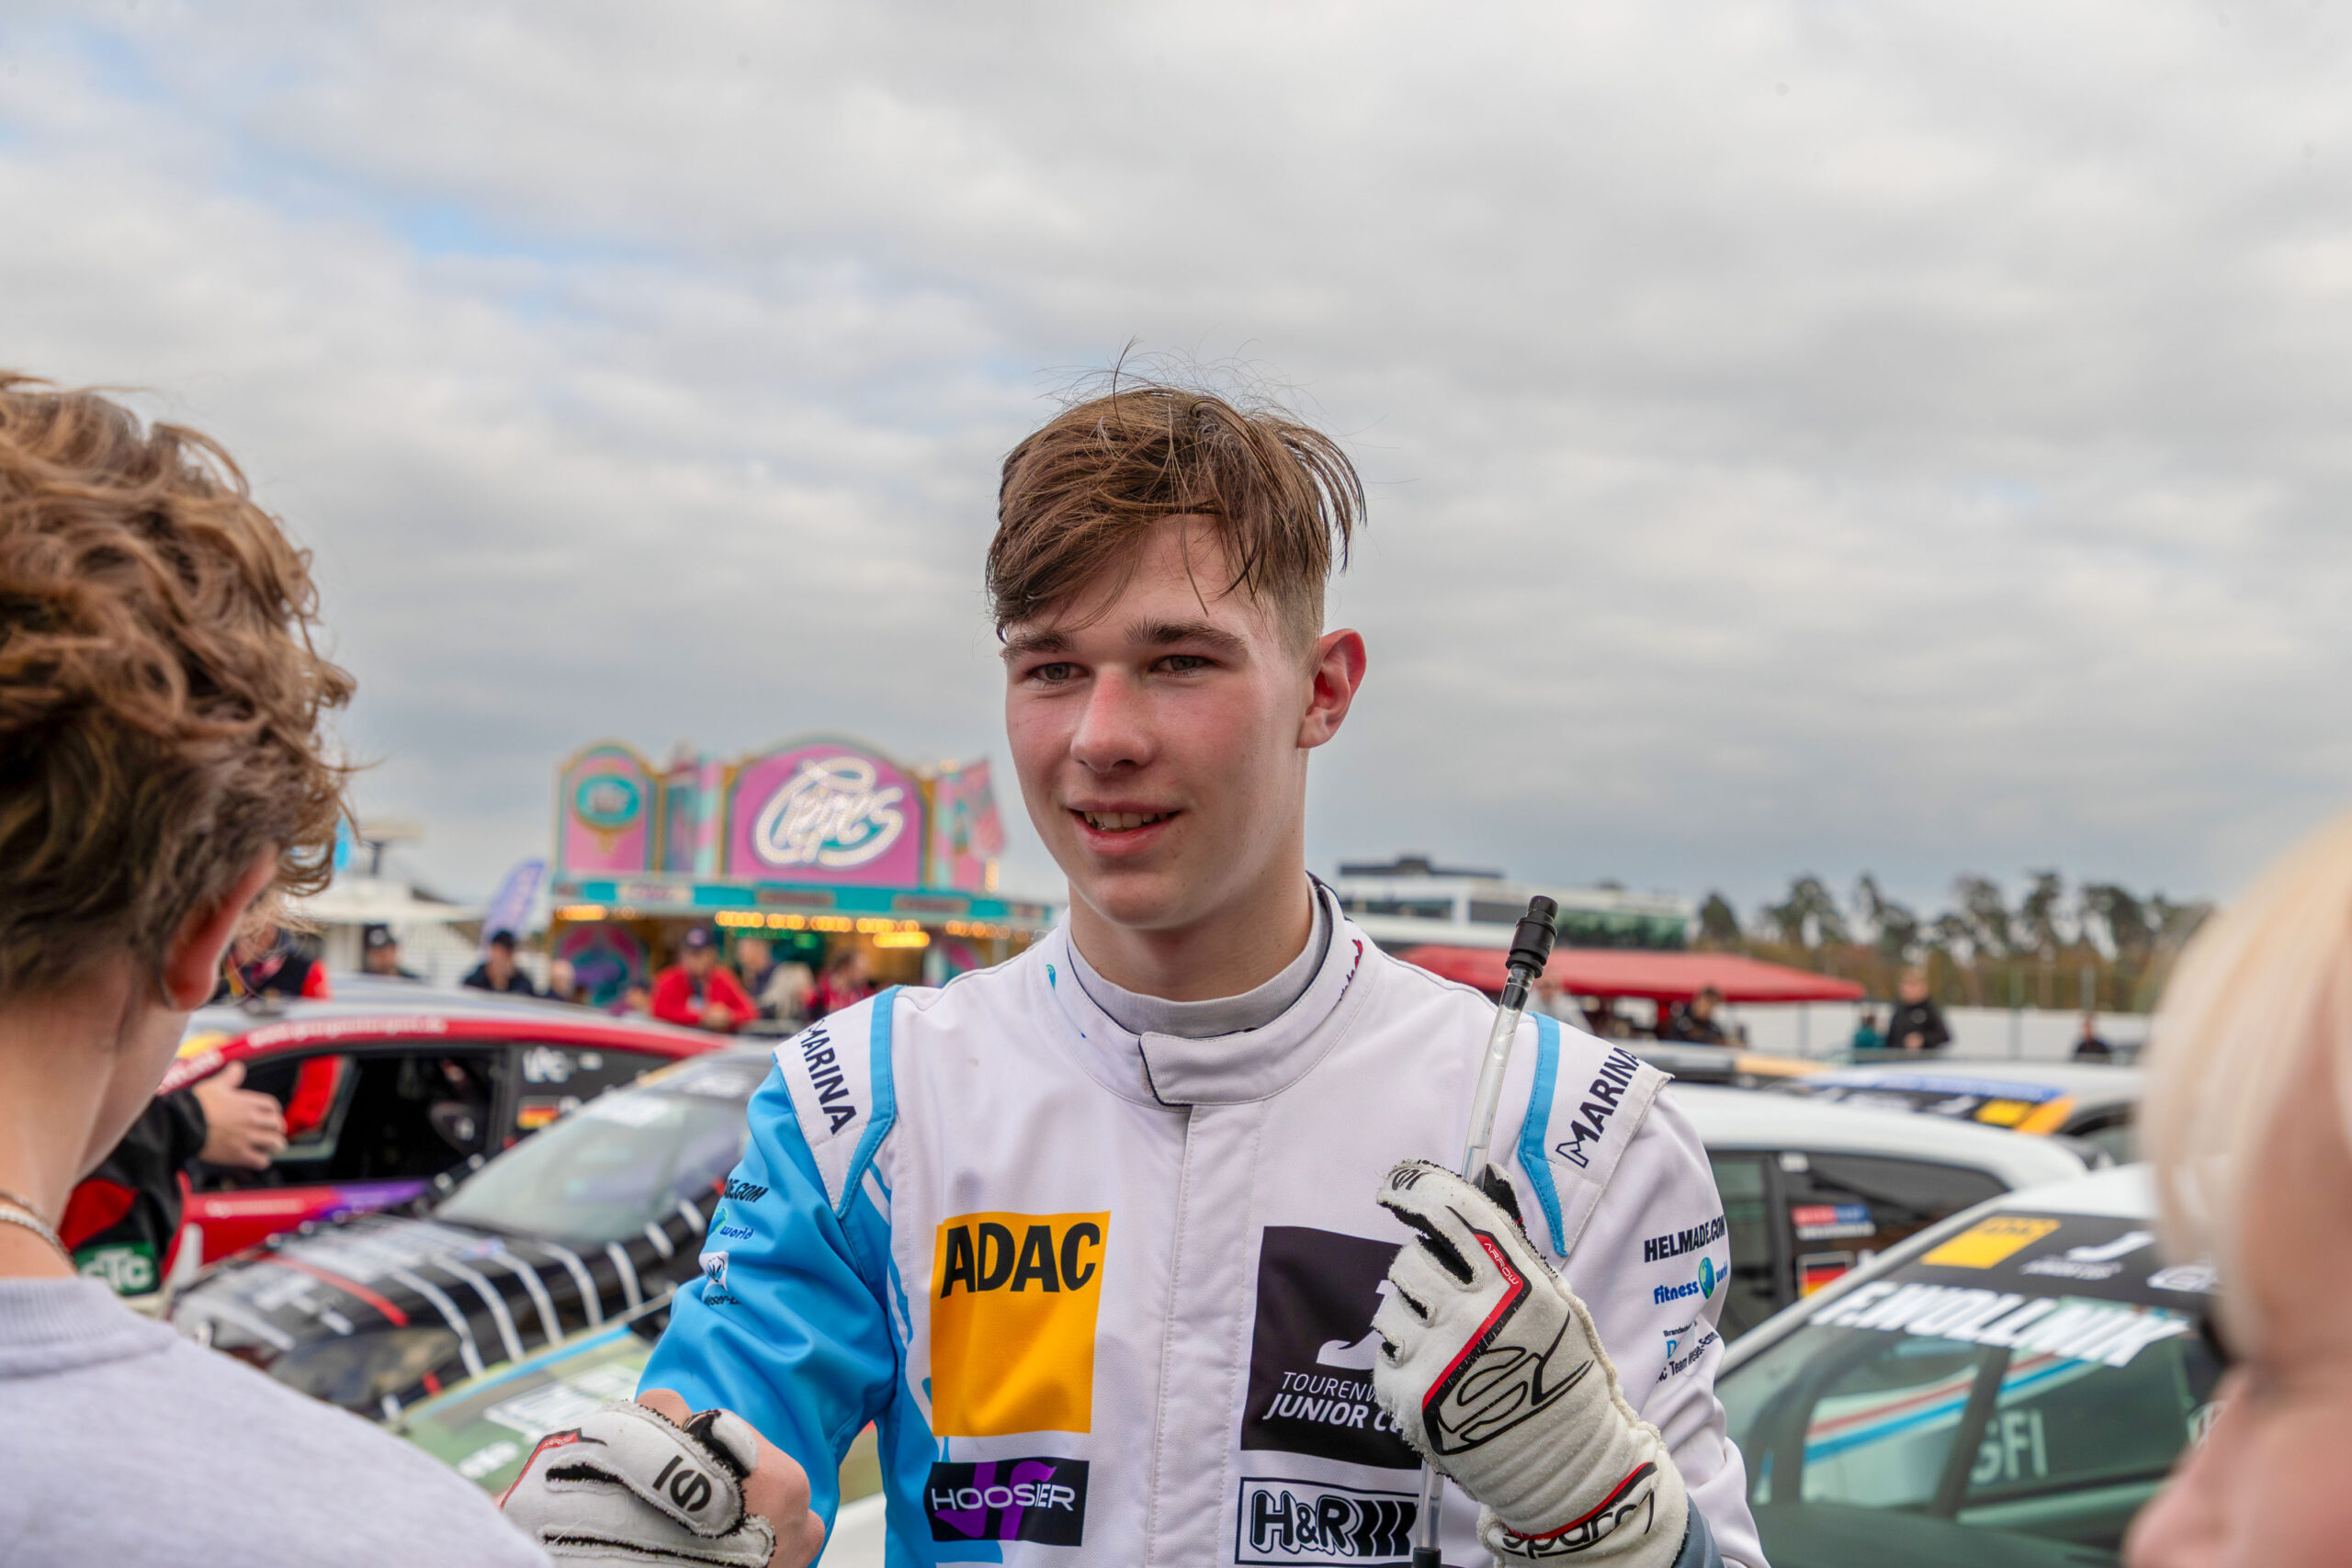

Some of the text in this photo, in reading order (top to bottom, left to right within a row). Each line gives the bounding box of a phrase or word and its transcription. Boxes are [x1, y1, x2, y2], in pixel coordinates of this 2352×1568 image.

[797, 1018, 857, 1135] MARINA
[1555, 1046, 1640, 1168] MARINA
[719, 1225, 754, 1240] world
[1644, 1214, 1725, 1264] HELMADE.COM
[940, 1222, 1101, 1299] ADAC
[1484, 1243, 1520, 1285] ARROW
[1654, 1280, 1699, 1305] fitness
[1261, 1393, 1369, 1429] JUNIOR
[931, 1482, 1076, 1513] HOOSIER
[1250, 1490, 1355, 1556] H&R
